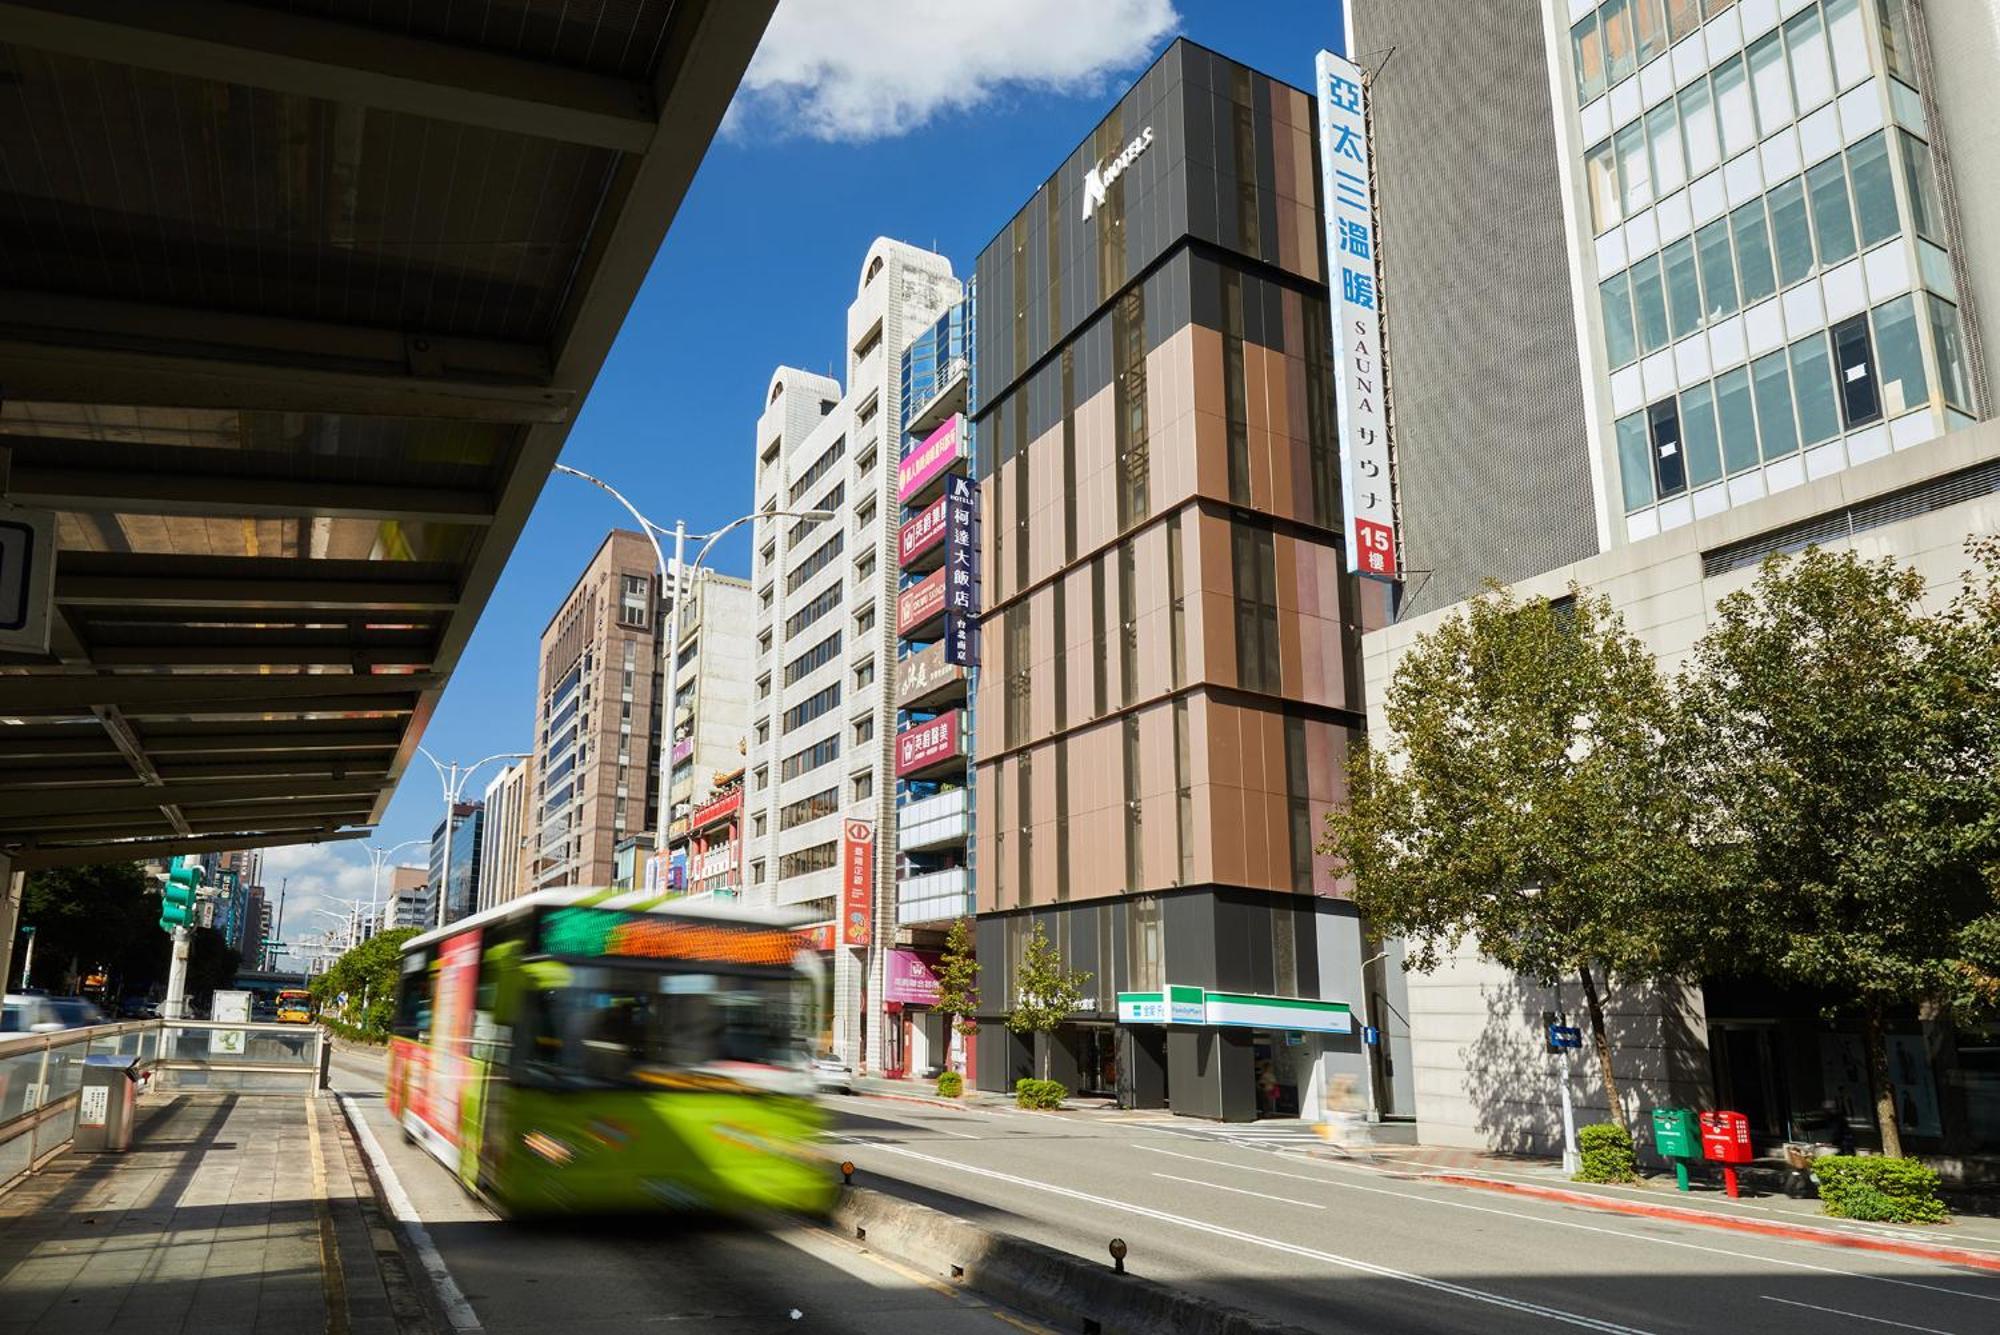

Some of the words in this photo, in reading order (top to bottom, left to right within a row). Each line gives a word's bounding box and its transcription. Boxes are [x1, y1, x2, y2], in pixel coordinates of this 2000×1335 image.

[1329, 73, 1374, 311] 亞太三溫暖
[1355, 320, 1373, 413] SAUNA
[1357, 427, 1382, 509] サウナ
[954, 508, 970, 608] 柯達大飯店
